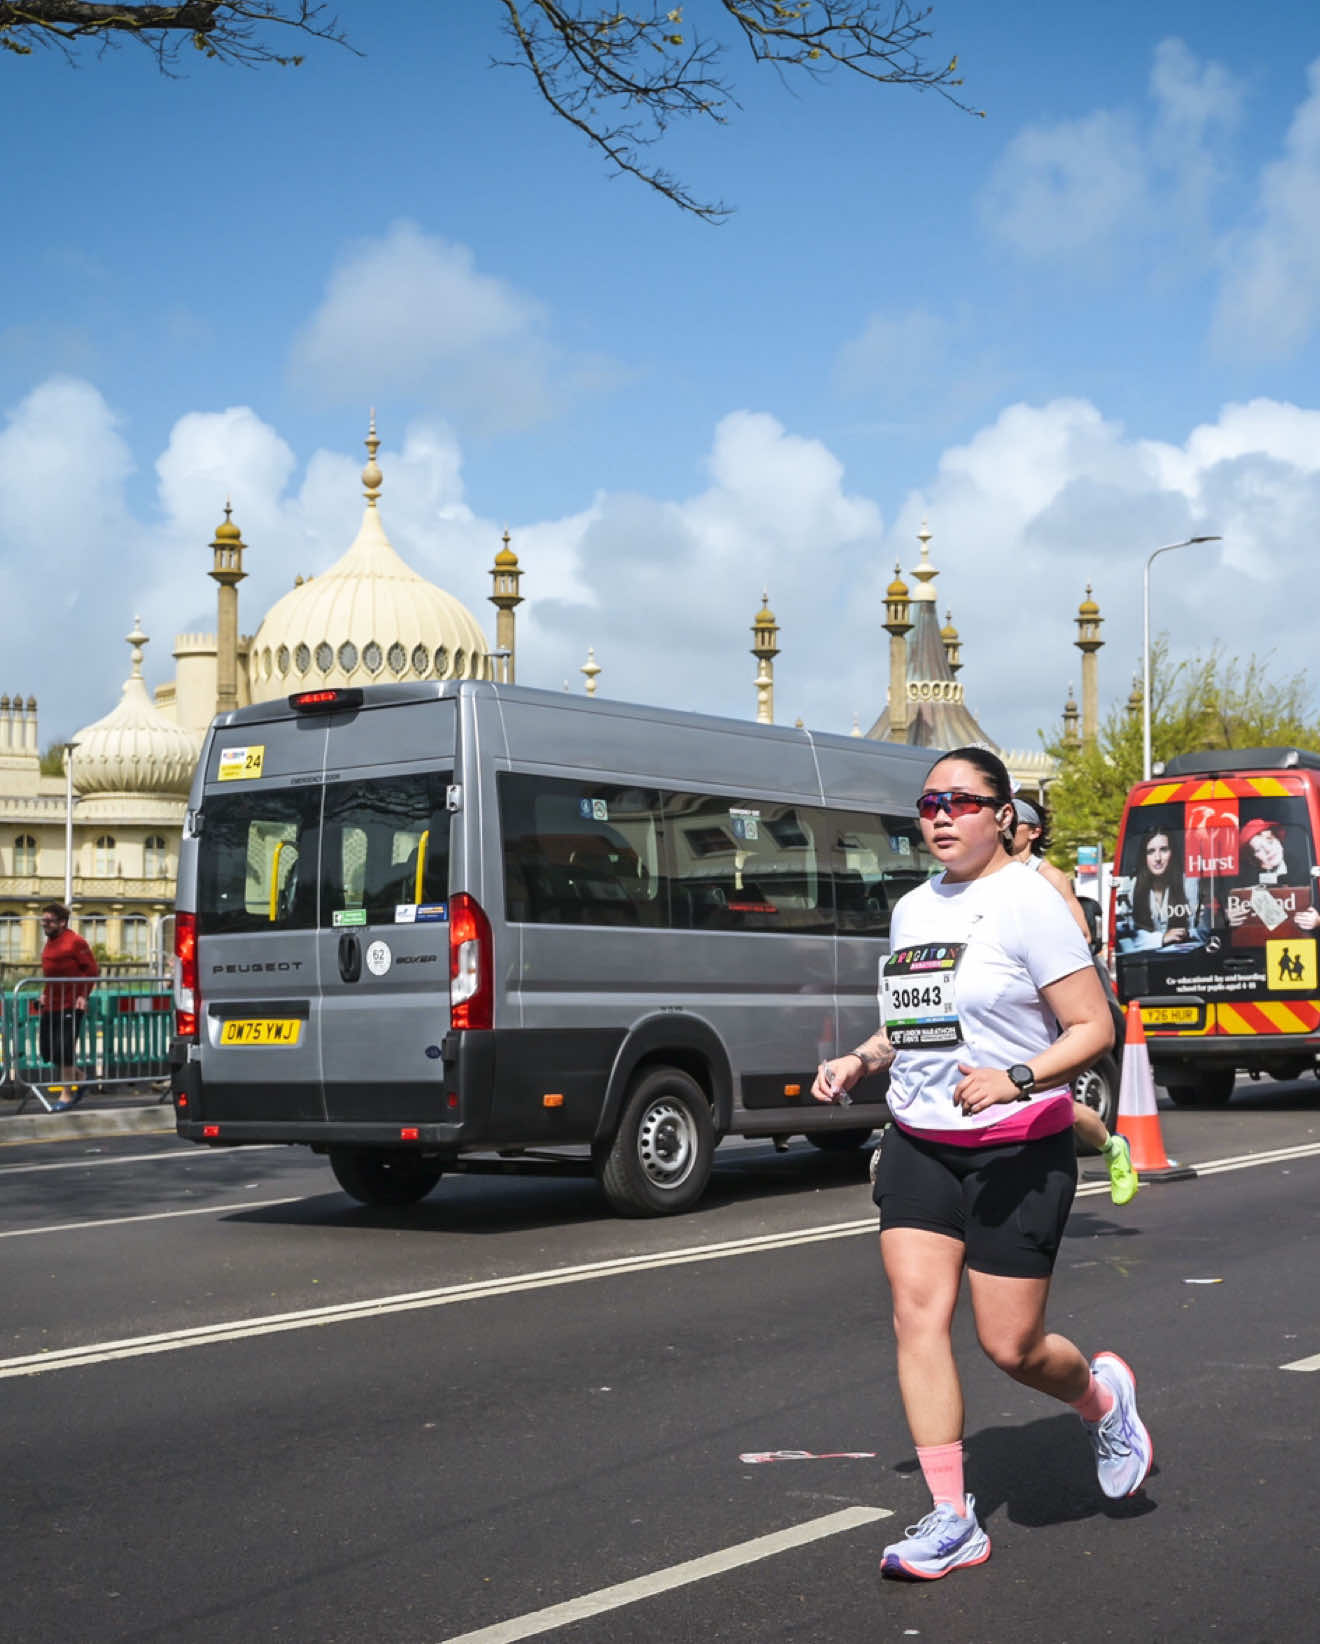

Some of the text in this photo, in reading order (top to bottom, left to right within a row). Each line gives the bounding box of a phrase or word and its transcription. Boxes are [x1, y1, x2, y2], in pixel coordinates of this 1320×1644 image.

[245, 754, 261, 770] 24
[1188, 854, 1235, 873] Hurst
[372, 949, 385, 961] 62
[395, 954, 438, 965] BOXER
[212, 961, 303, 975] PEUGEOT
[892, 986, 942, 1009] 30843
[266, 1022, 295, 1040] YWJ
